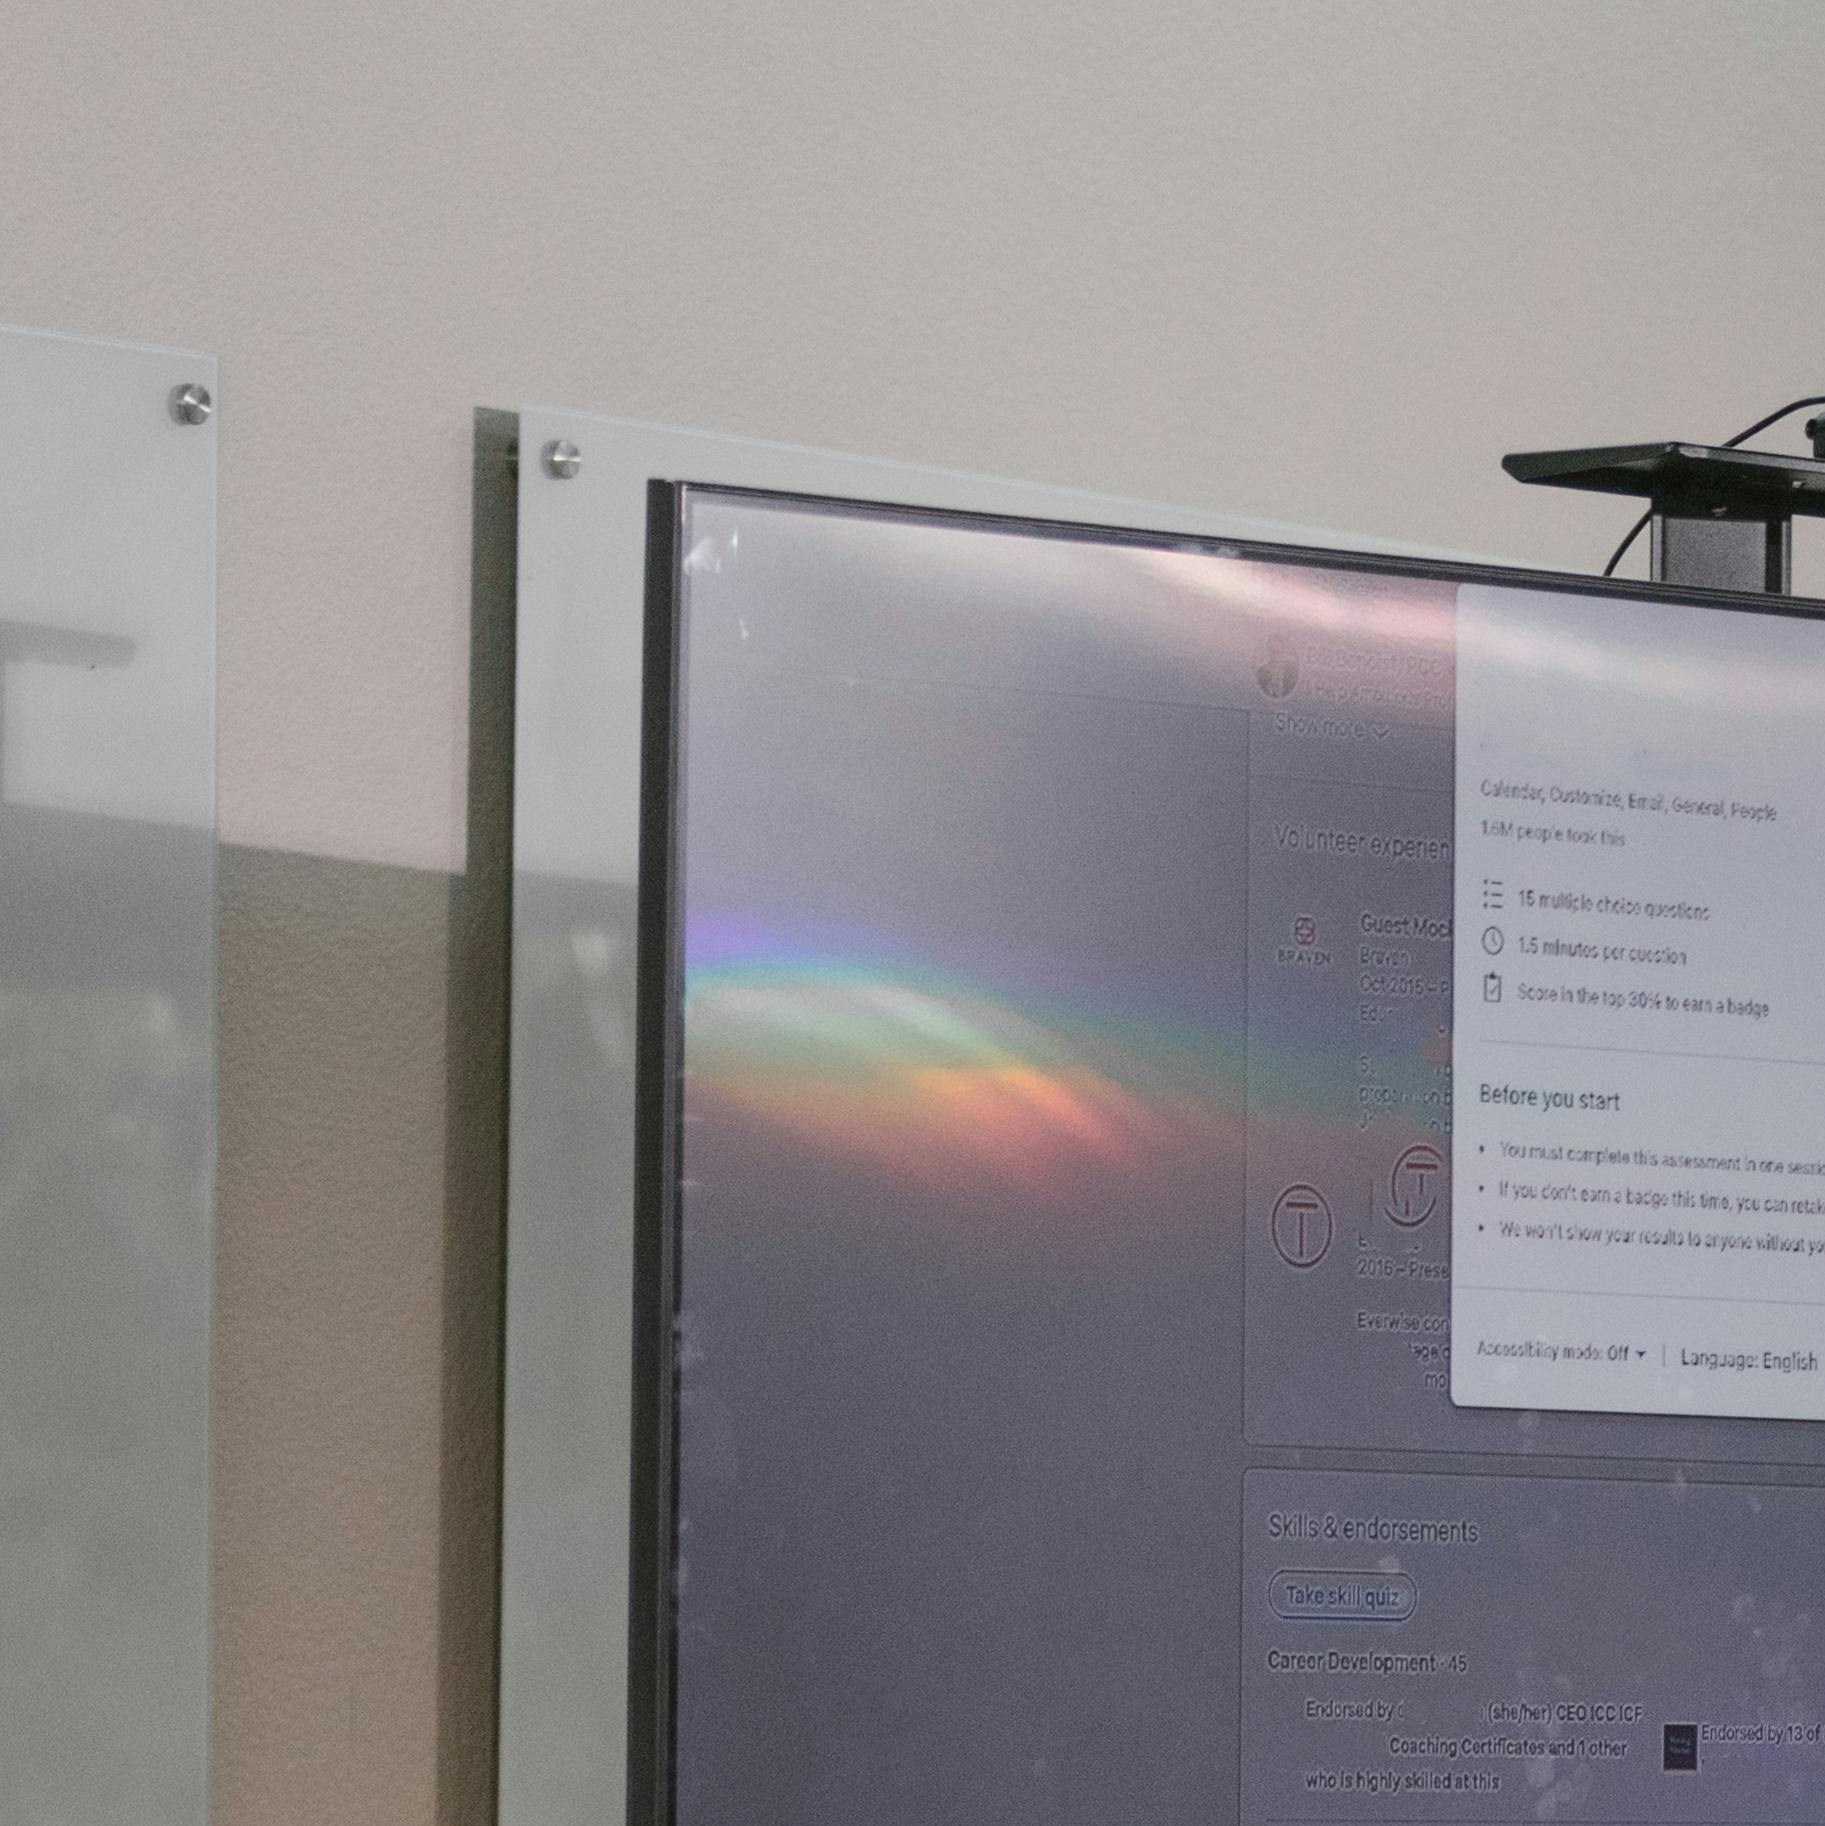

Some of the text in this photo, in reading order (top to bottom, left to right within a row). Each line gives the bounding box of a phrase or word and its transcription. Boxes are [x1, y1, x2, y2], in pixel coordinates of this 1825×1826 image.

[1274, 823, 1365, 854] Volunteer
[1360, 912, 1409, 936] Guest
[1479, 1083, 1619, 1112] Before you start
[1762, 1350, 1817, 1375] English
[1269, 1514, 1476, 1542] Skills & endorsements
[1285, 1585, 1401, 1608] Take skill quiz
[1268, 1650, 1322, 1670] Career
[1328, 1653, 1434, 1675] Development
